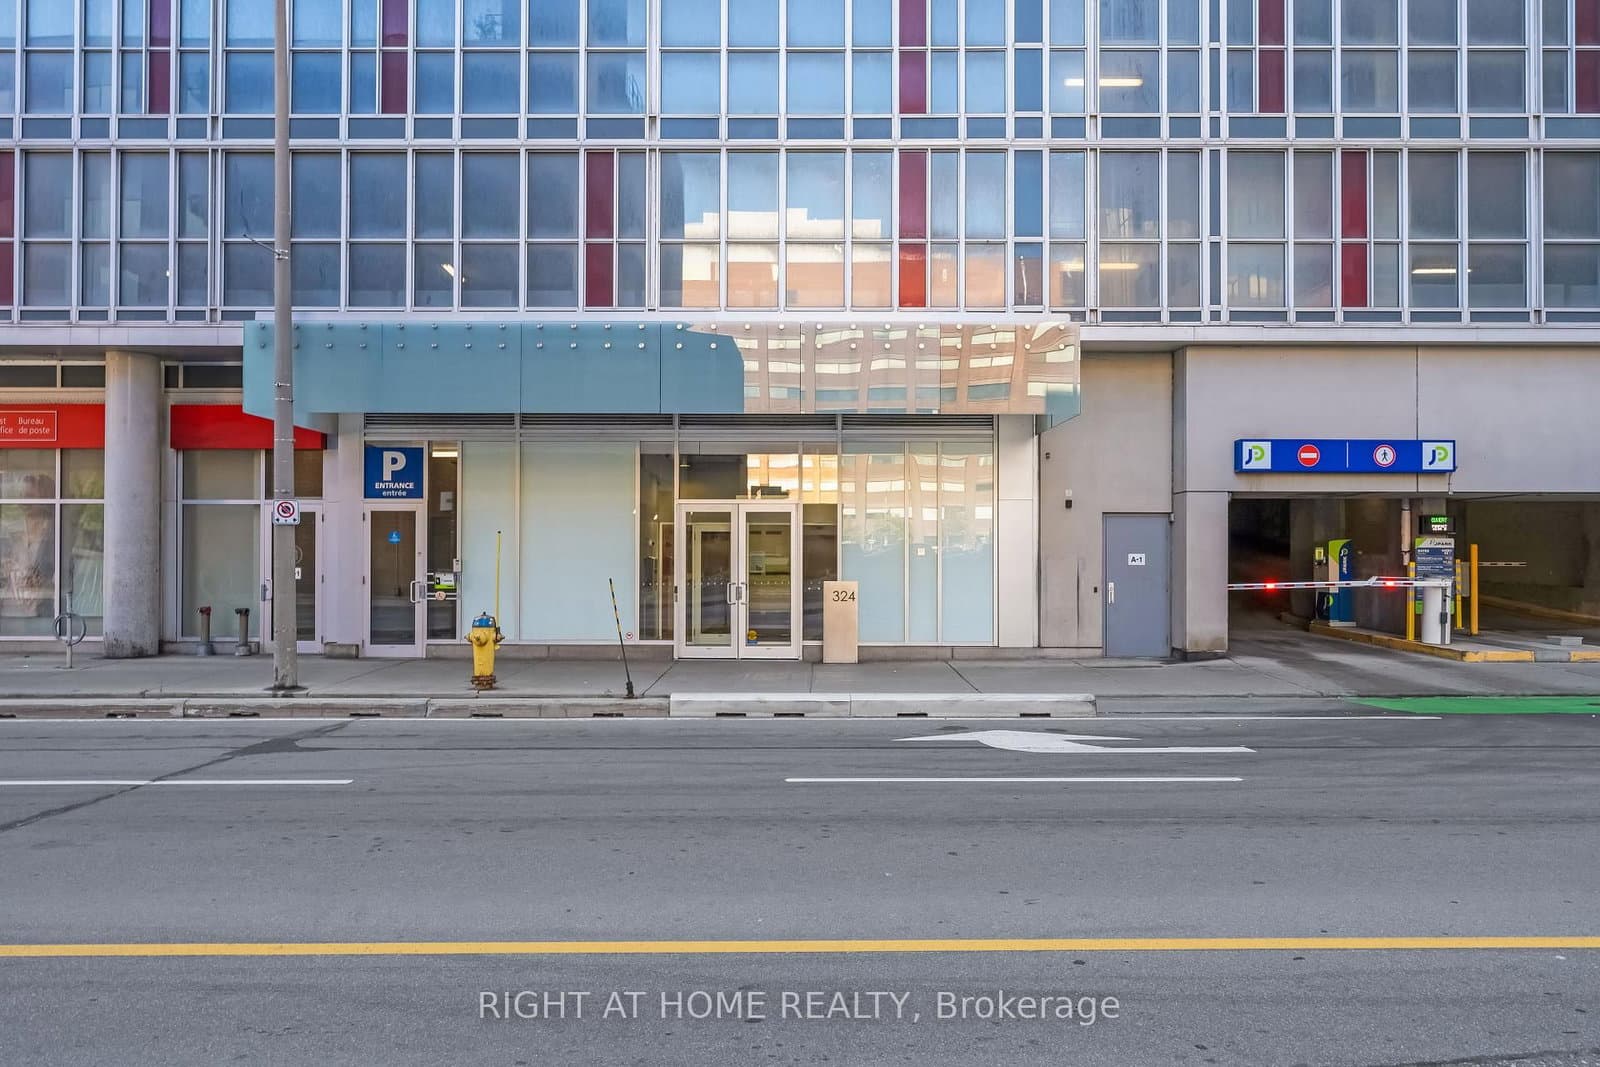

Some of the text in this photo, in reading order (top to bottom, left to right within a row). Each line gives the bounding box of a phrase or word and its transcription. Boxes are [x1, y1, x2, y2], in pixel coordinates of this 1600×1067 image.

[18, 416, 45, 425] Bureau
[18, 425, 50, 436] de poste
[382, 451, 406, 481] P
[832, 590, 856, 602] 324
